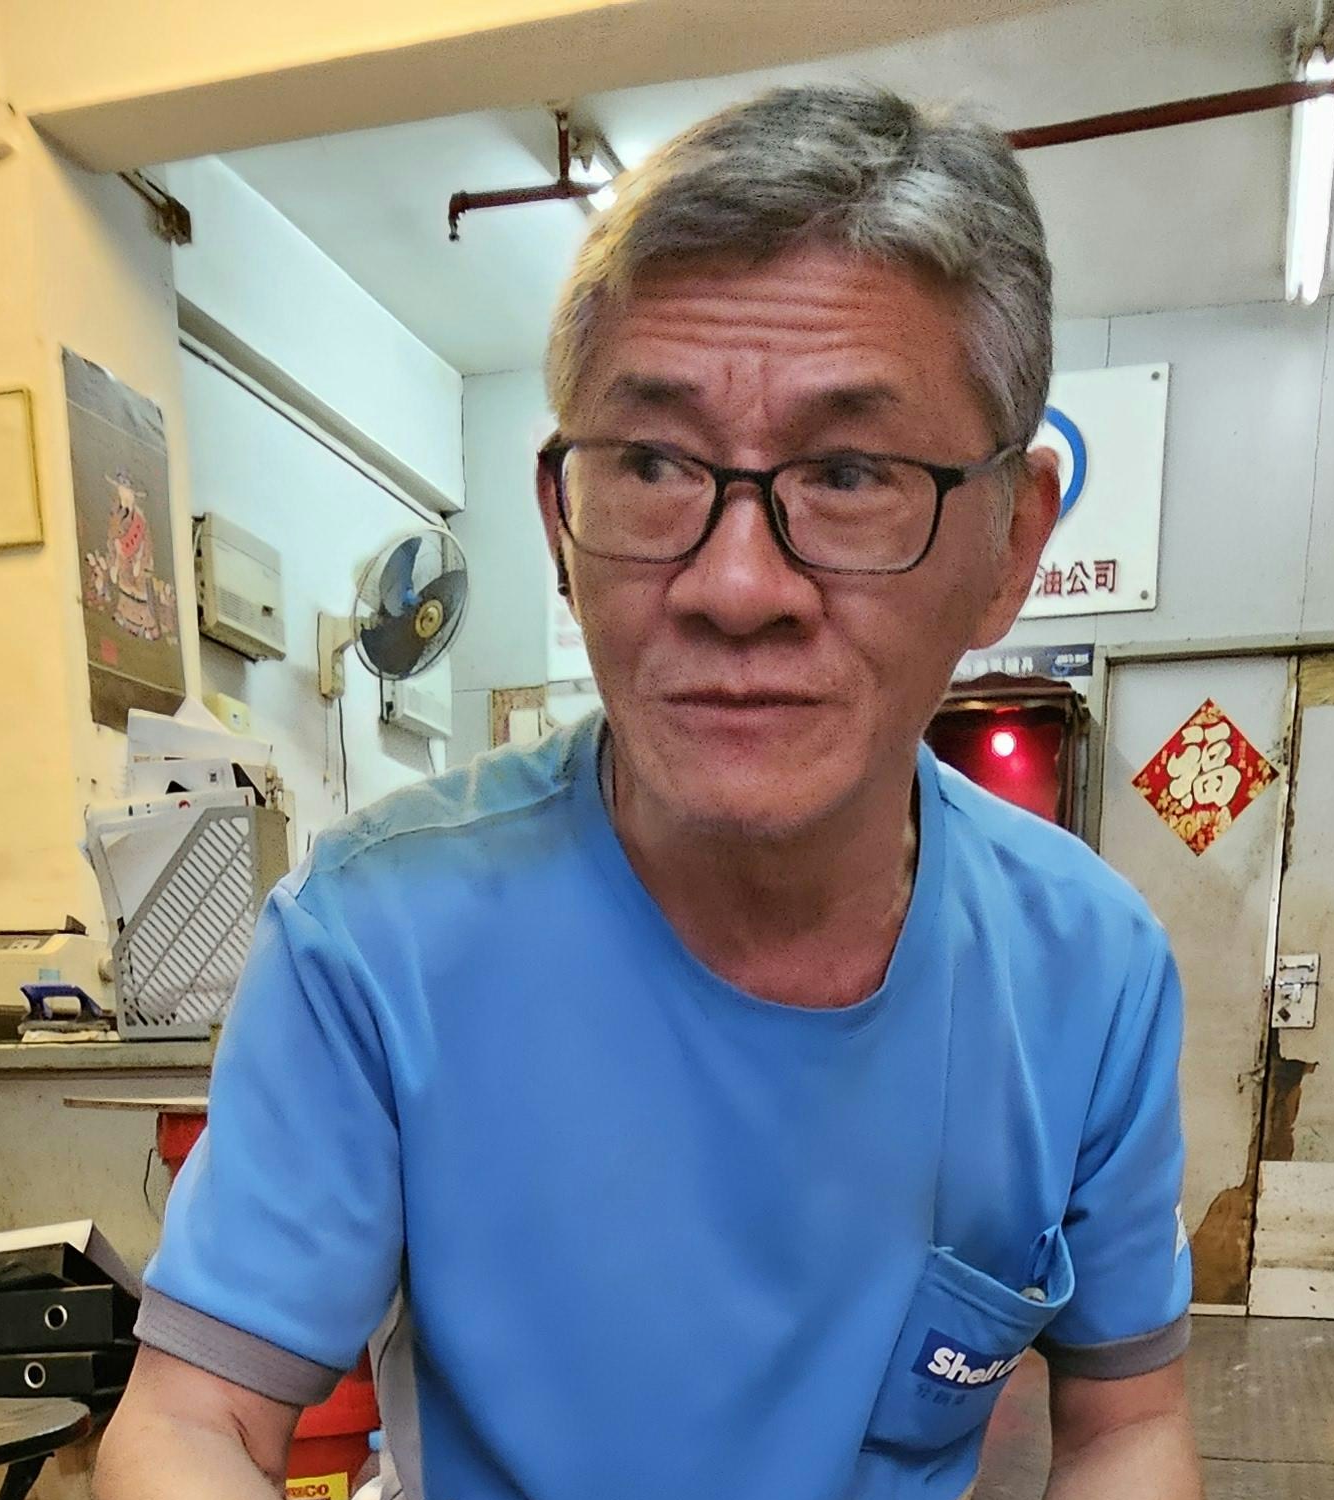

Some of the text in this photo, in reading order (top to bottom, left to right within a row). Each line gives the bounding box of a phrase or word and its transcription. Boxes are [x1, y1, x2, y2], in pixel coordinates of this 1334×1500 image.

[1036, 559, 1119, 597] 油公司
[1167, 721, 1242, 810] 福
[927, 1346, 1005, 1384] Shell
